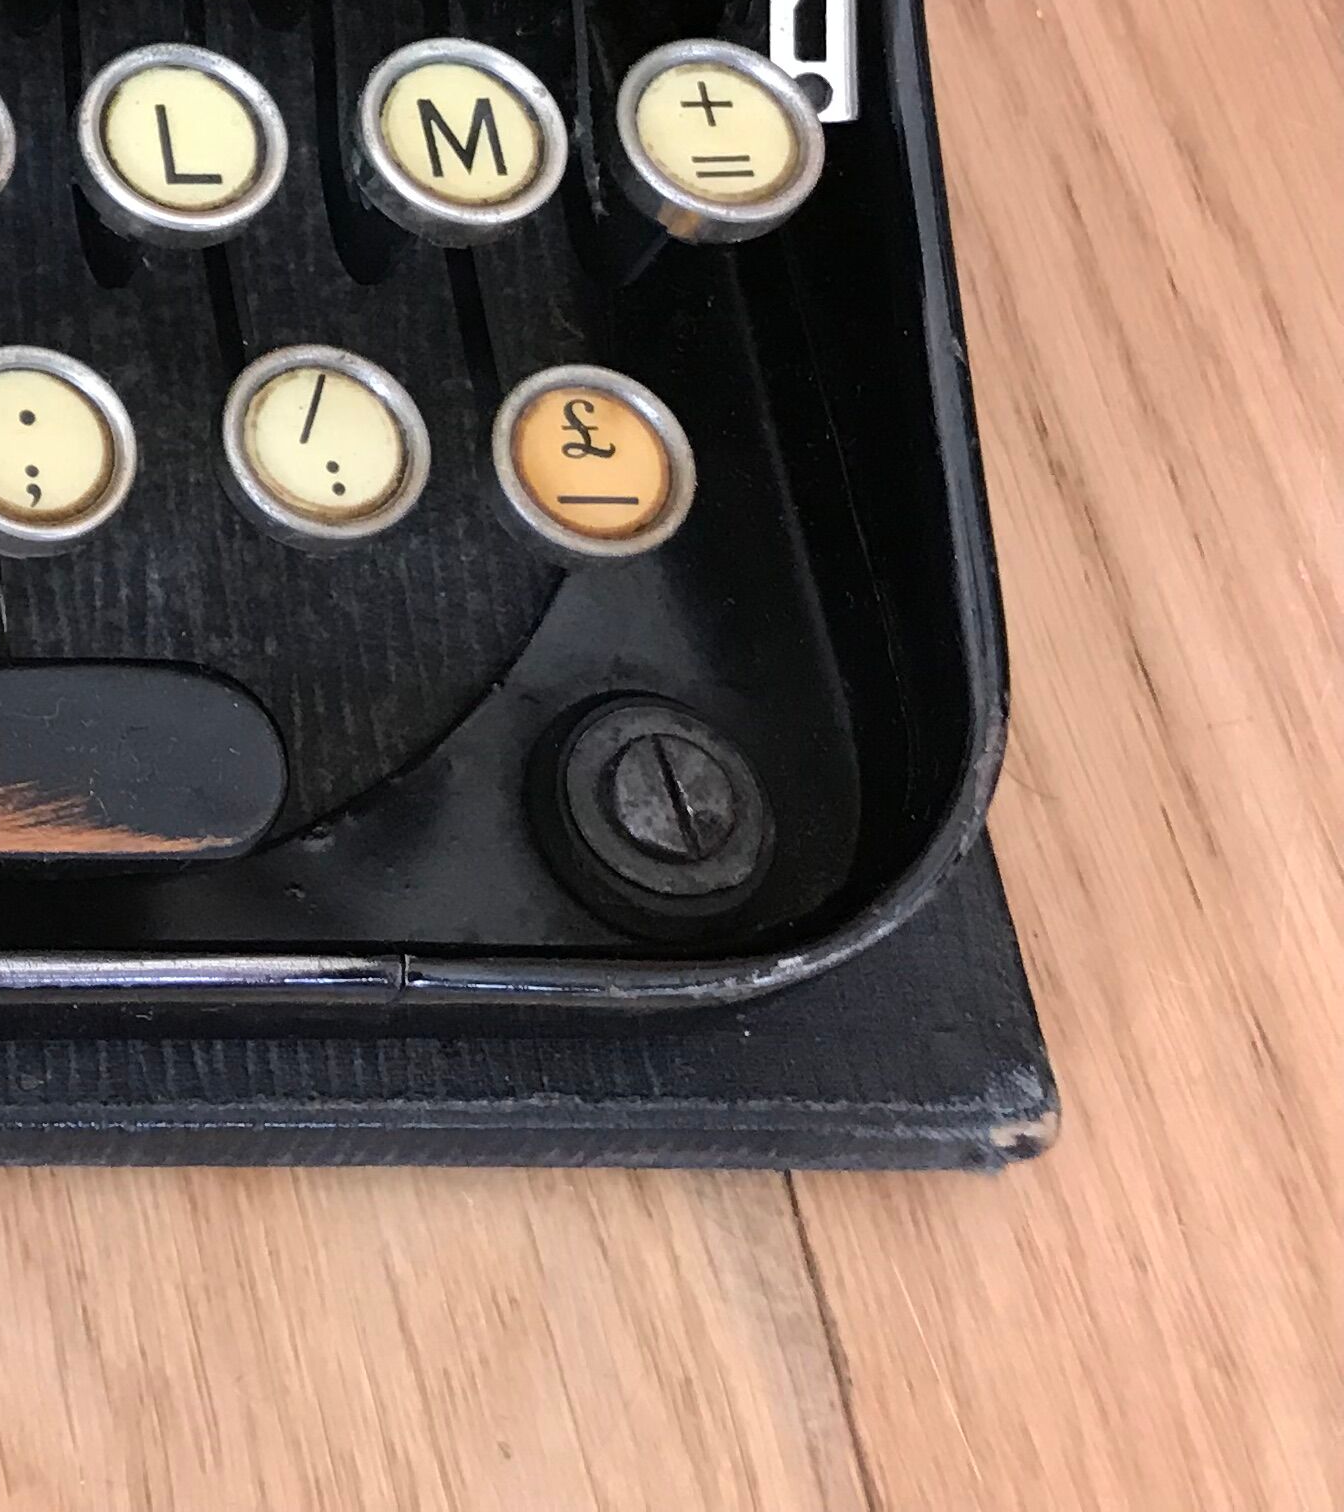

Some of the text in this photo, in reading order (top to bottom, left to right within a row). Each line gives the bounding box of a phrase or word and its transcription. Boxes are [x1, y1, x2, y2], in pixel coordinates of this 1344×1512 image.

[682, 82, 732, 126] +
[156, 105, 222, 184] L
[416, 97, 508, 178] M
[692, 155, 754, 178] =
[300, 374, 327, 443] /
[563, 399, 615, 458] £
[26, 465, 41, 507] ;
[327, 461, 345, 495] :
